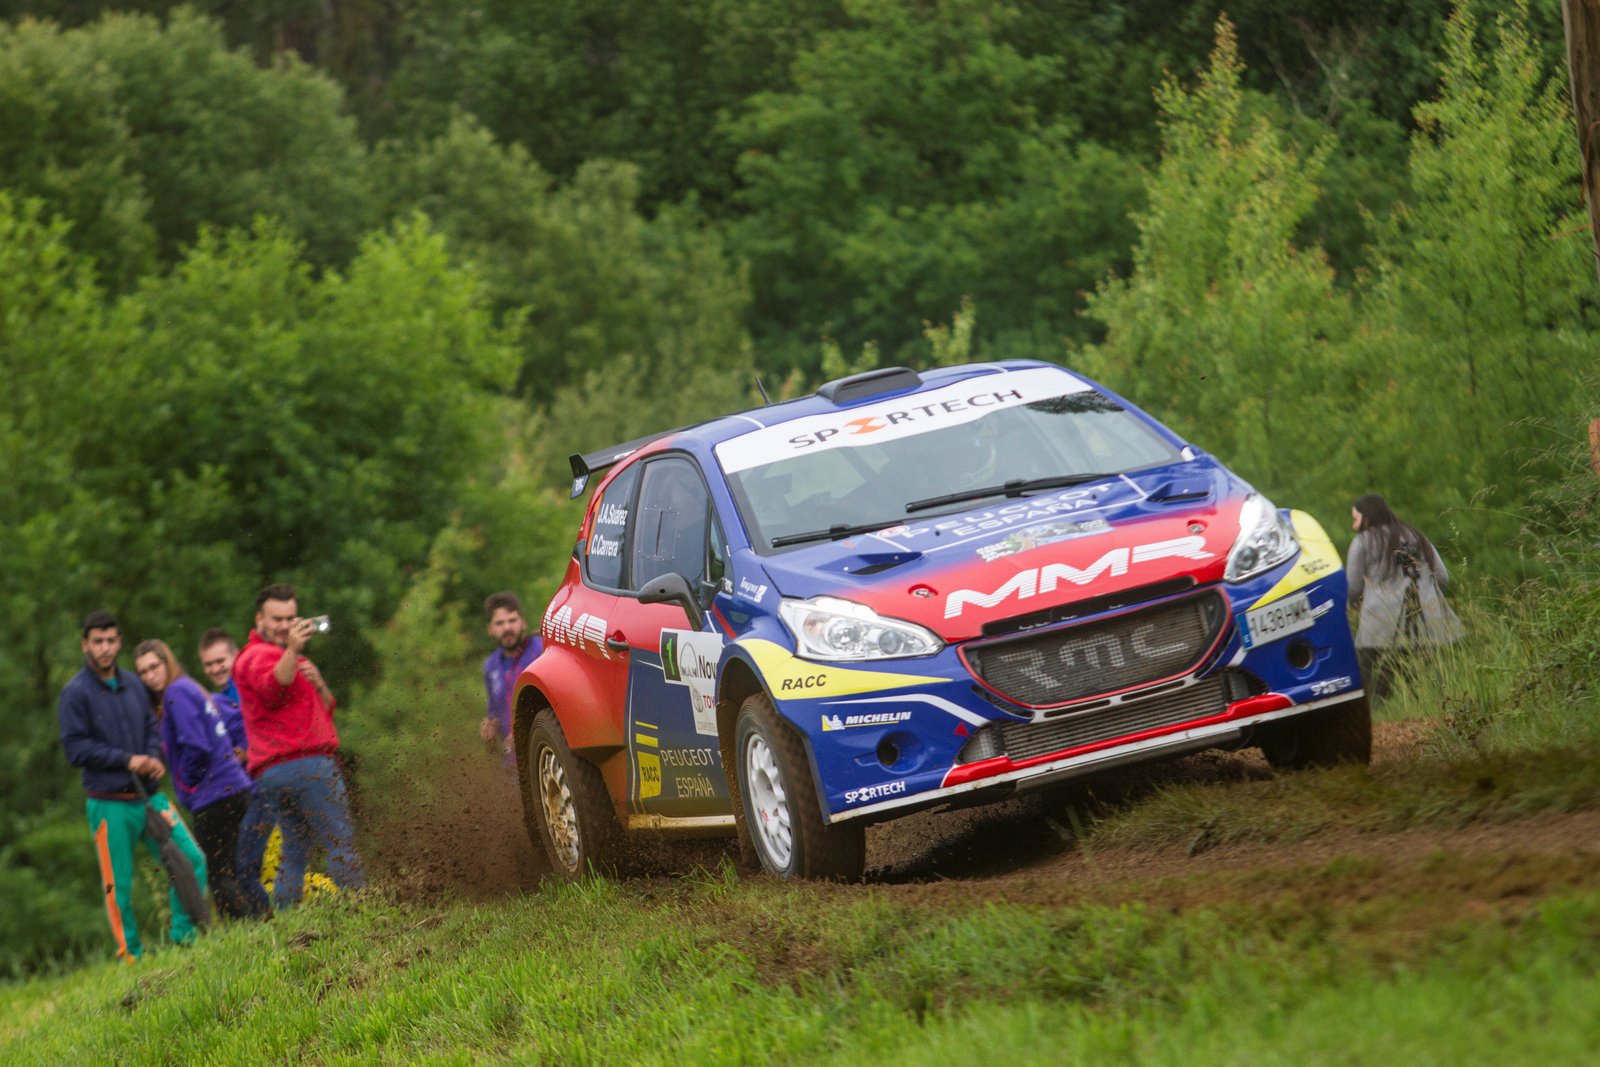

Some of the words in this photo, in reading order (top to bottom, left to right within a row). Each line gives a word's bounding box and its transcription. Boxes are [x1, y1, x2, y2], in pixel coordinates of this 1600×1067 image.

[789, 389, 1023, 449] SPORTECH
[944, 536, 1215, 620] MMR
[666, 637, 675, 675] 1
[781, 674, 827, 691] RACC
[845, 711, 912, 725] MICHELIN
[660, 748, 714, 767] PEUGEOT
[641, 766, 660, 783] RACC
[675, 773, 715, 798] ESPAÑA
[845, 780, 906, 804] SPORTECH
